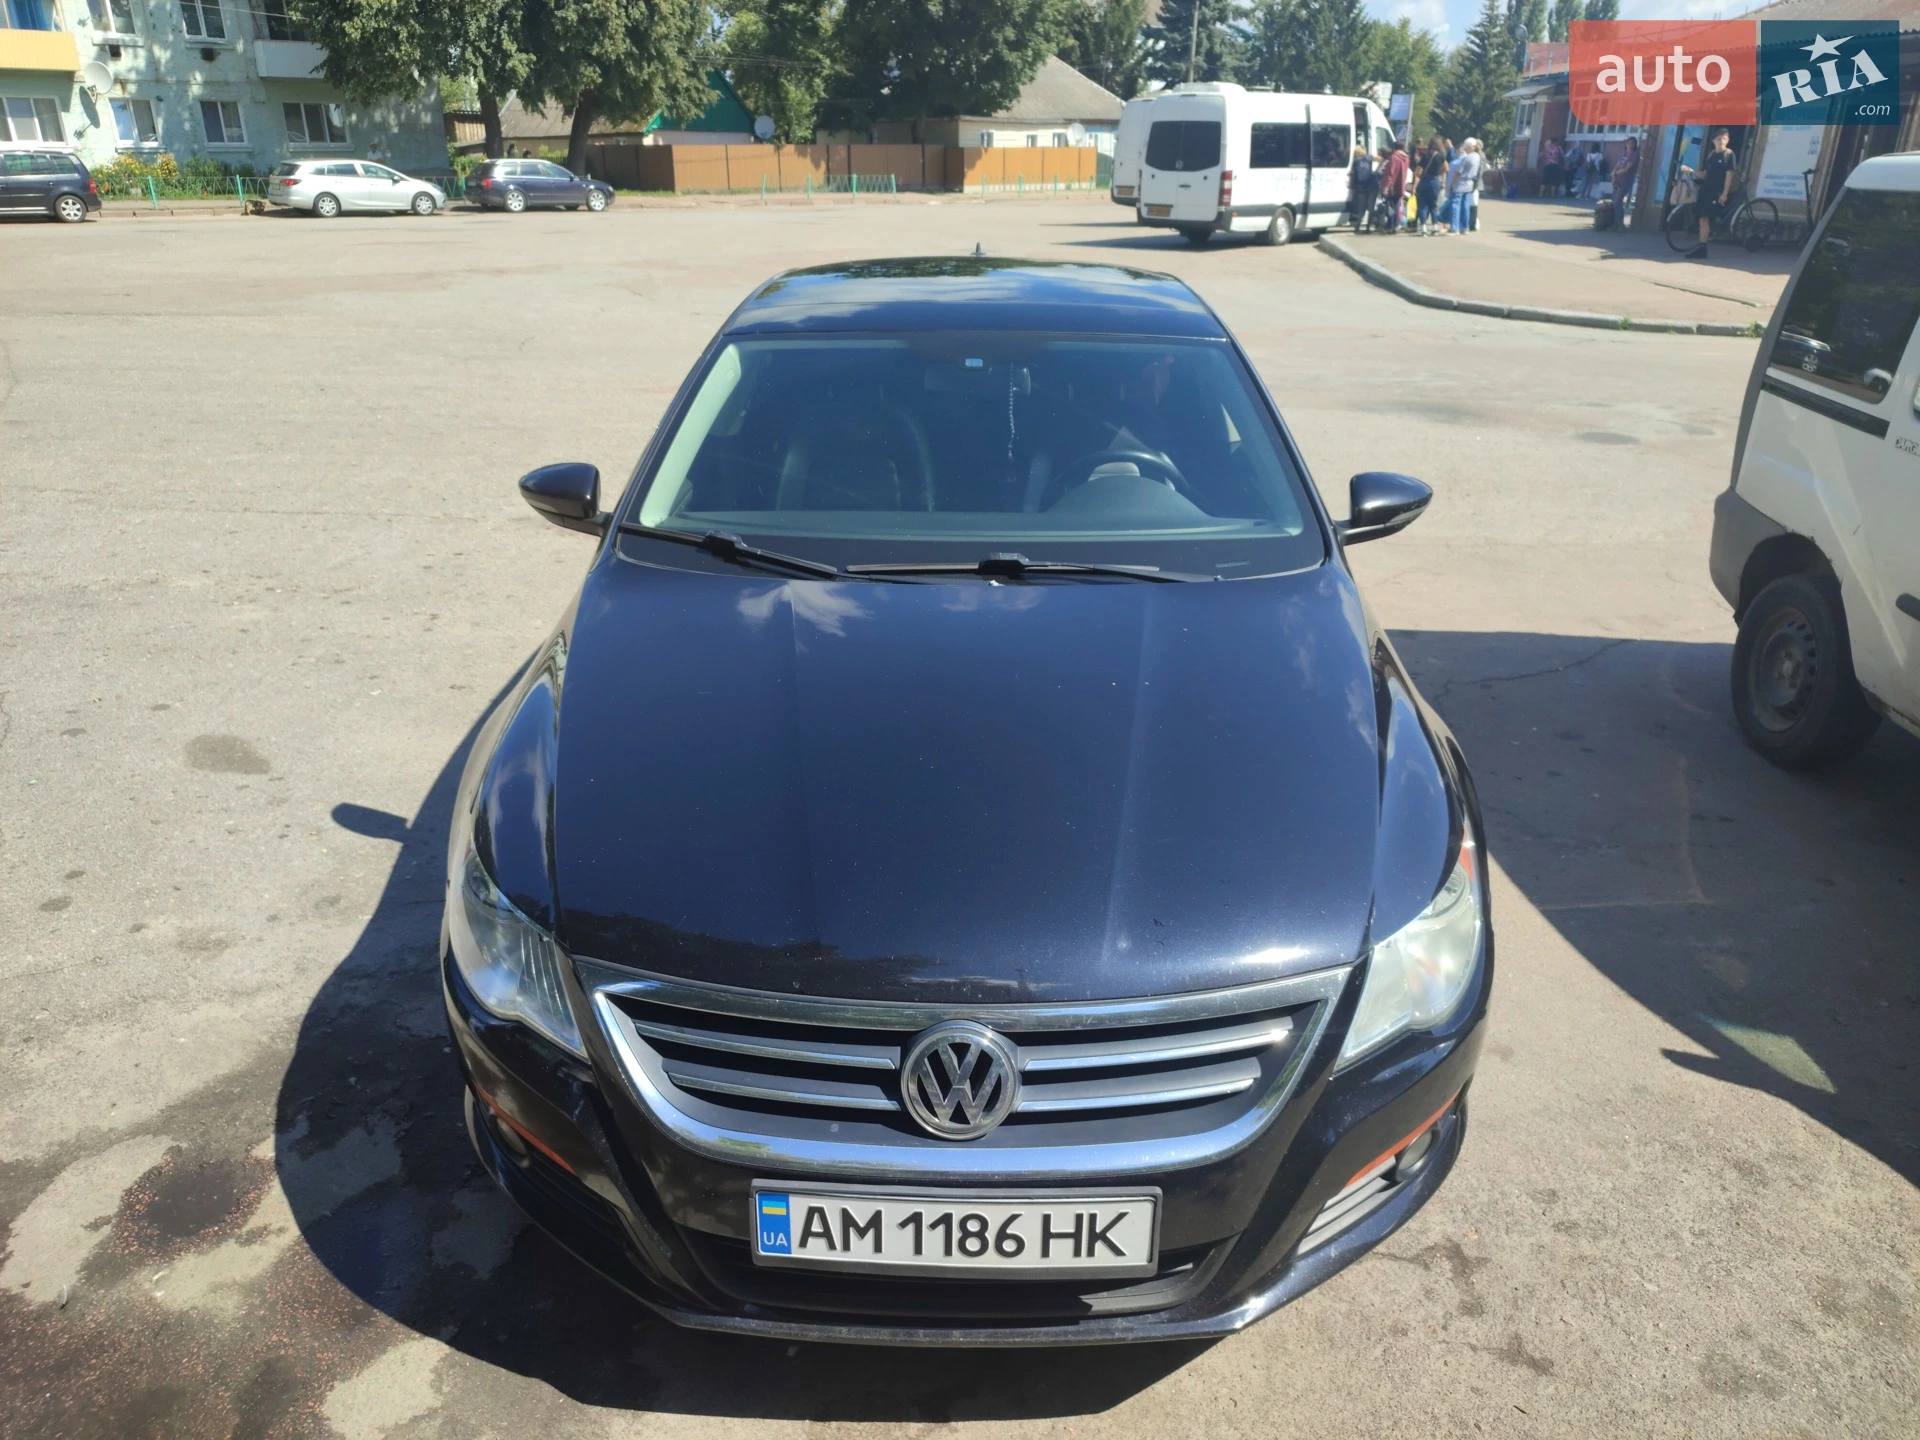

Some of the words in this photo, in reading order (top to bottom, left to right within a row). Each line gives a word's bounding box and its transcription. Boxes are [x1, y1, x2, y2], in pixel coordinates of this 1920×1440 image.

[763, 1232, 788, 1247] UA
[799, 1205, 883, 1254] AM
[897, 1210, 1026, 1258] 1186
[1040, 1210, 1131, 1258] HK
